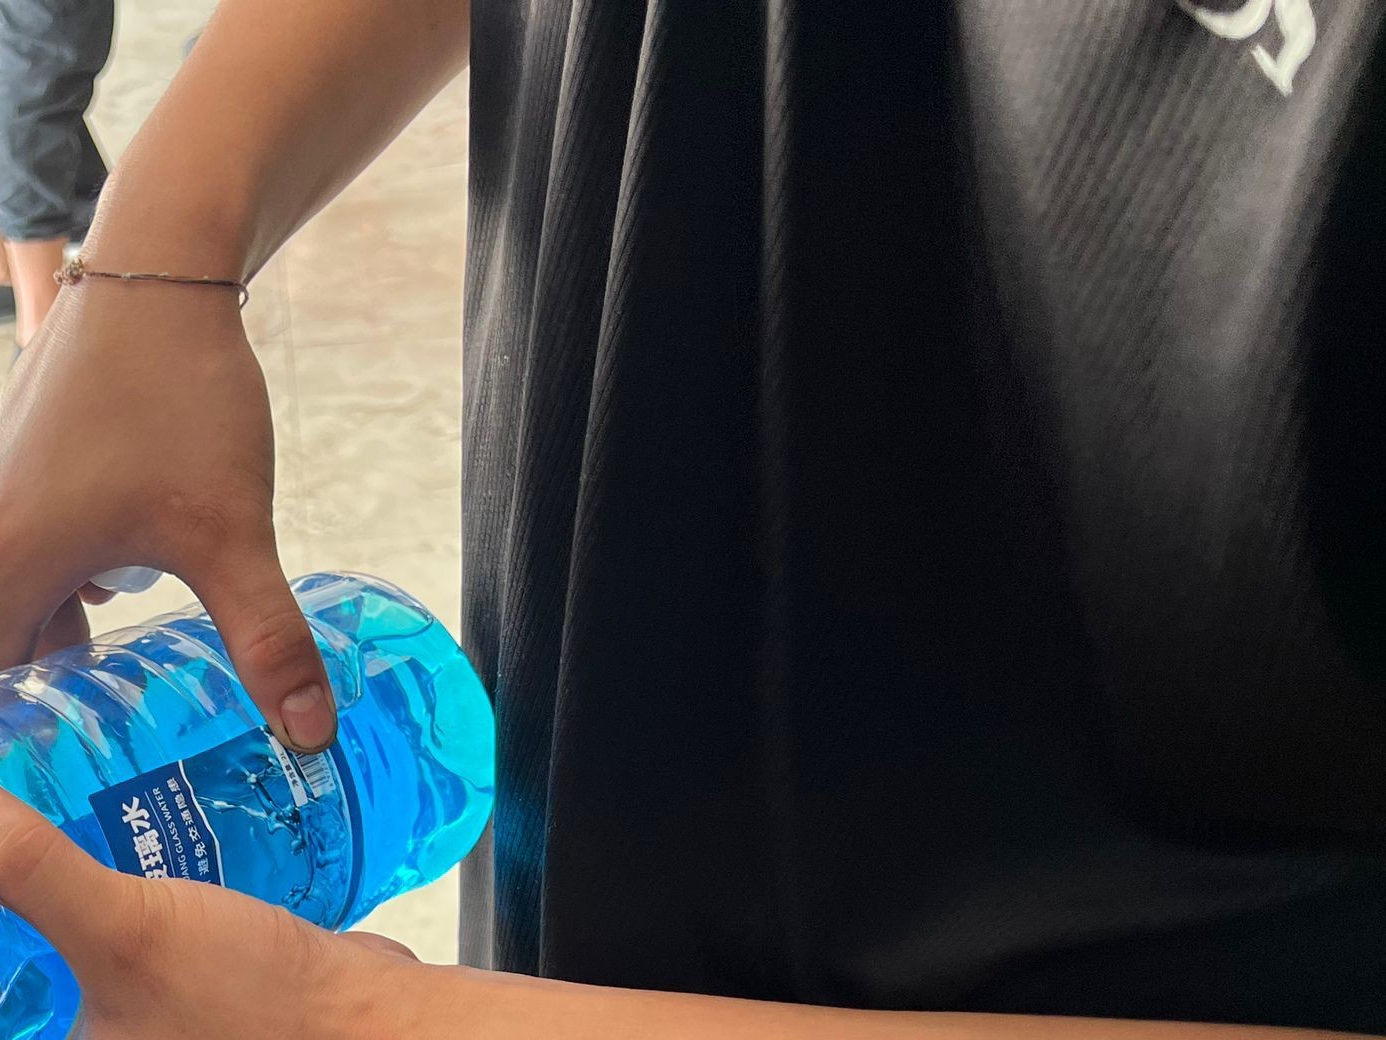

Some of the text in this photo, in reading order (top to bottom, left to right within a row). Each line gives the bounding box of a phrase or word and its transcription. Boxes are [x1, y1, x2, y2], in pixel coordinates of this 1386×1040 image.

[152, 787, 172, 822] WATER
[166, 777, 209, 876] 避免交通隐患
[167, 821, 184, 854] GLASS
